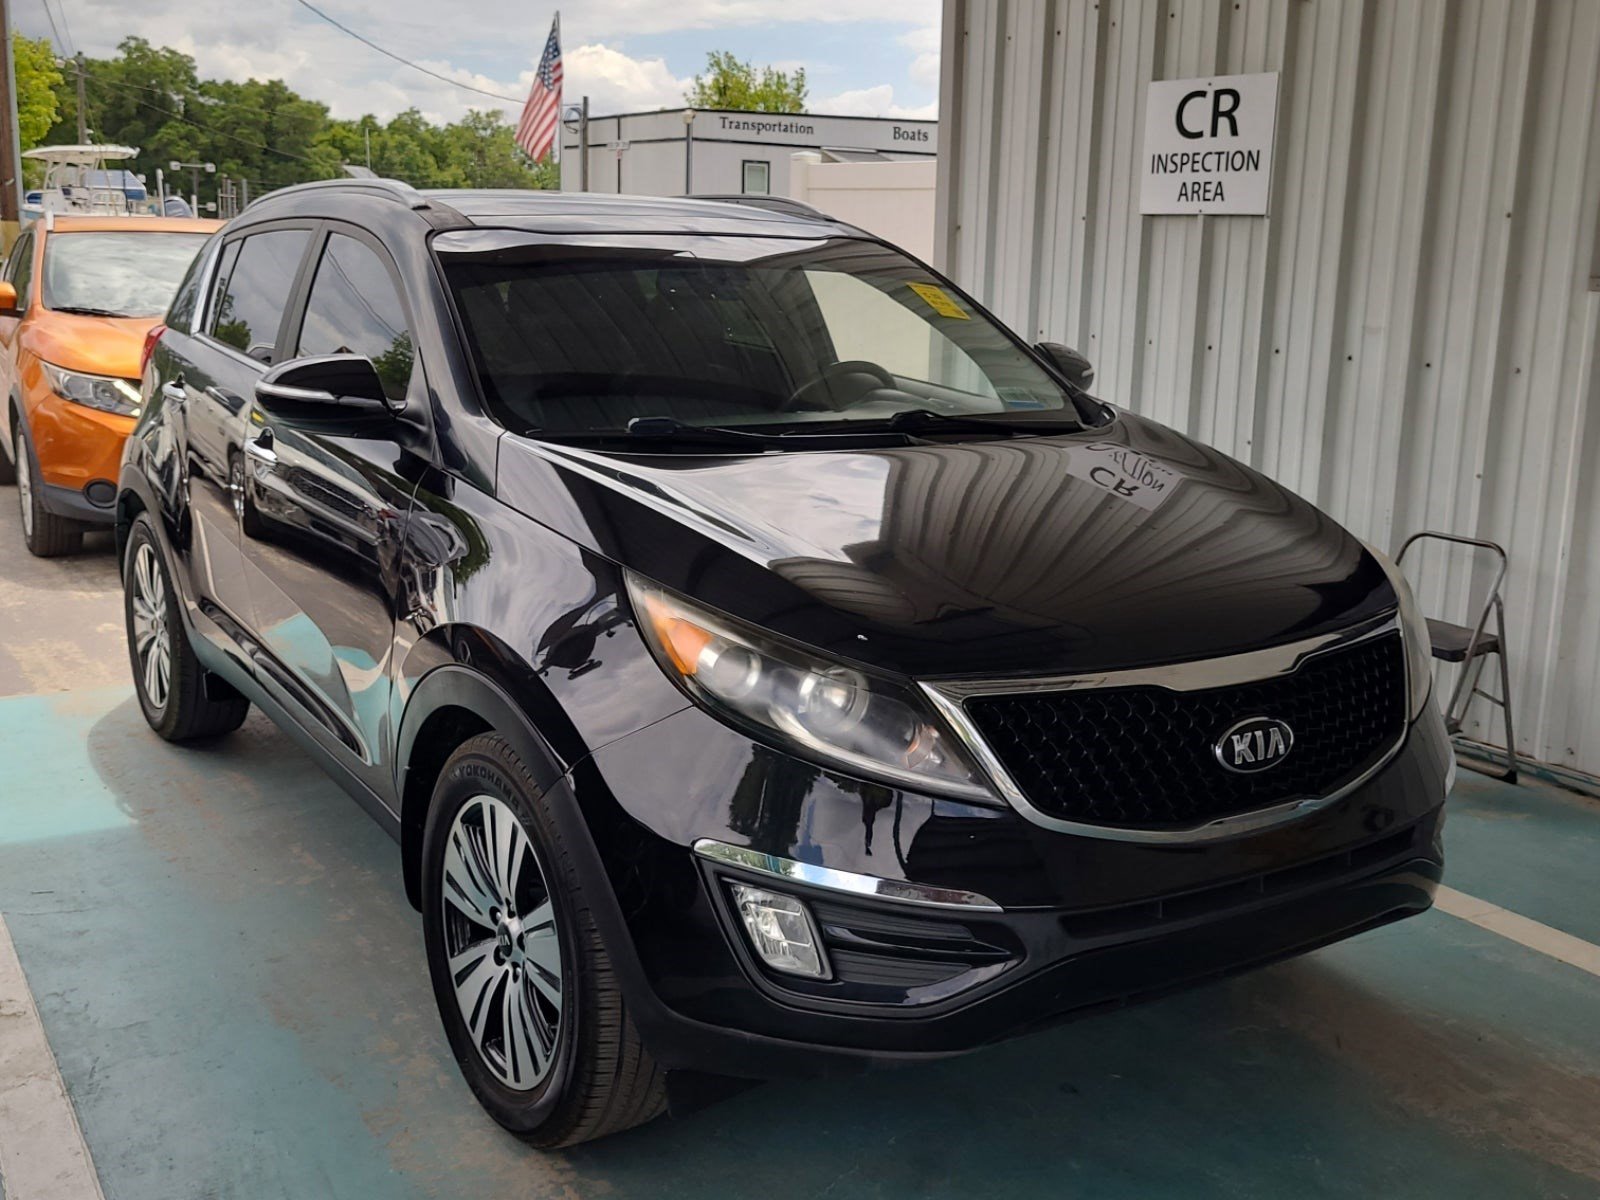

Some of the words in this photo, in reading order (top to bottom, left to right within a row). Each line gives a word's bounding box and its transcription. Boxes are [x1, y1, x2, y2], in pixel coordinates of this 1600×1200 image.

[719, 116, 814, 136] Transportation
[1175, 88, 1241, 140] CR
[893, 126, 929, 142] Boats
[1151, 149, 1260, 175] INSPECTION
[1177, 181, 1225, 202] AREA
[1231, 727, 1286, 765] KIA
[458, 764, 520, 811] YOKOHAMA
